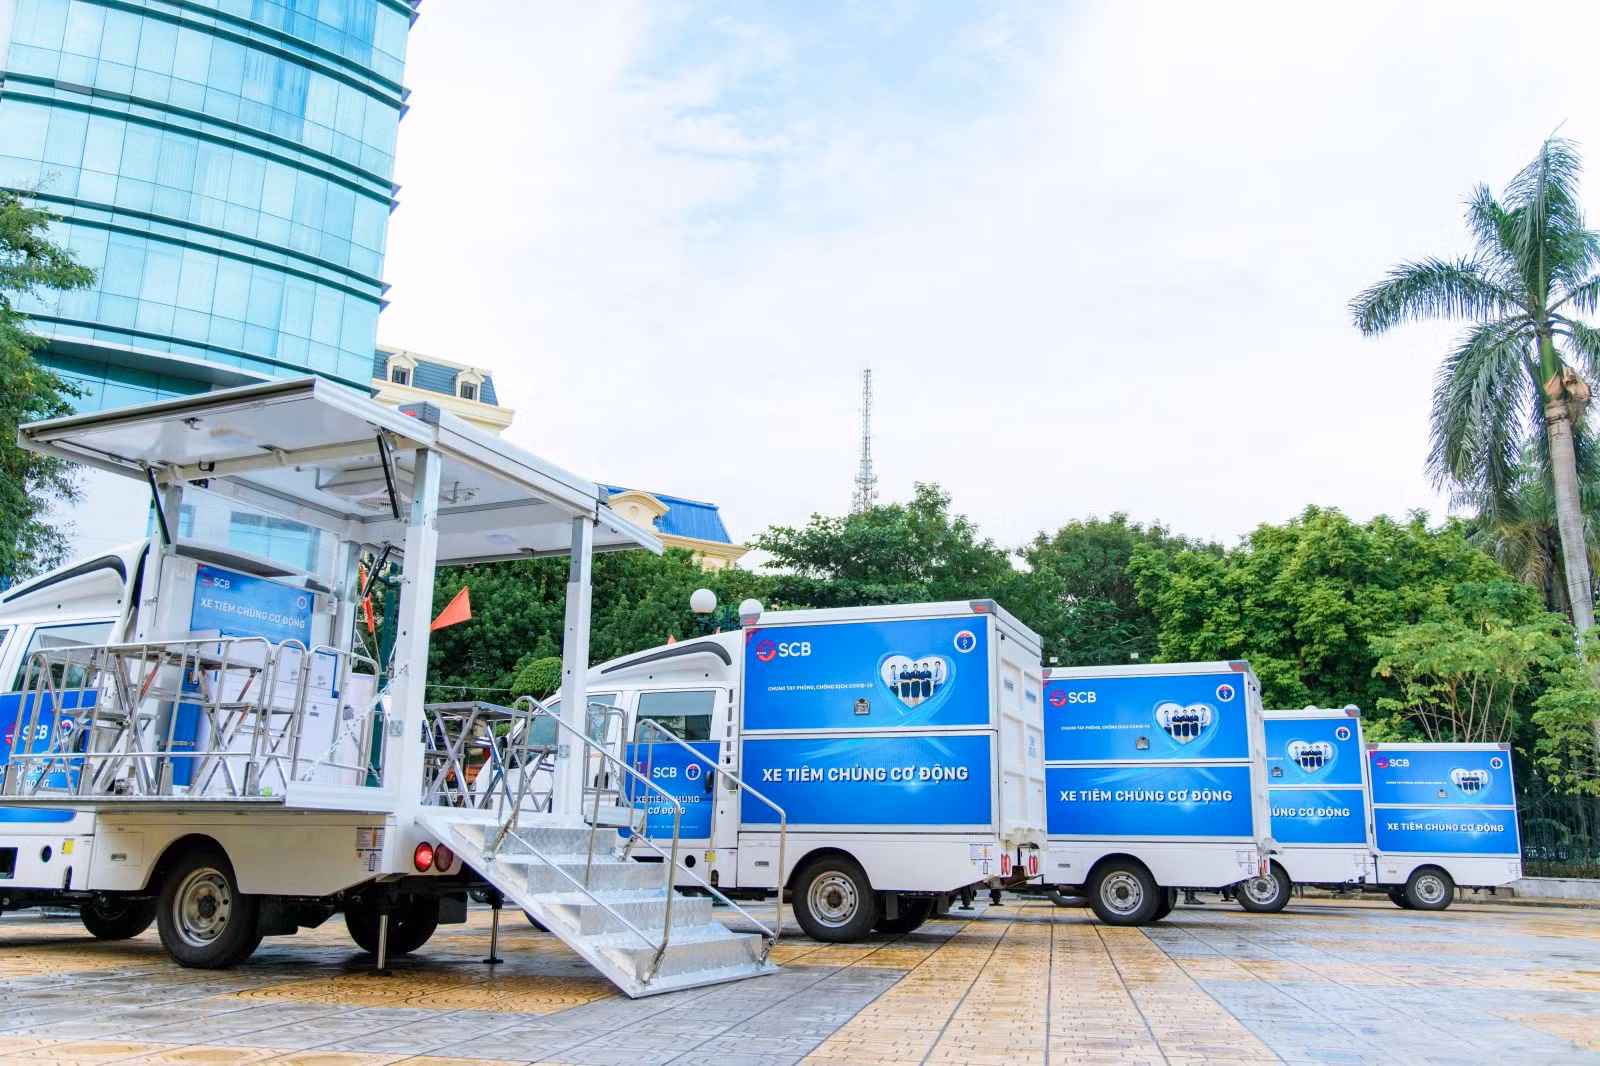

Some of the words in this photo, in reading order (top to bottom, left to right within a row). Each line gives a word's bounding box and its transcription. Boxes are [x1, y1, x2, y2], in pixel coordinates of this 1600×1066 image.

[213, 577, 230, 589] SCB
[201, 597, 212, 609] XE
[778, 642, 812, 657] SCB
[1068, 691, 1096, 704] SCB
[1389, 758, 1409, 767] SCB
[653, 767, 677, 779] SCB
[762, 768, 782, 782] XE
[786, 765, 824, 782] TIÊM
[828, 763, 887, 782] CHỦNG
[890, 765, 916, 781] CƠ
[918, 763, 969, 784] ĐỘNG
[671, 793, 700, 803] HỦNG
[1060, 790, 1077, 801] XE
[1080, 788, 1112, 802] TIÊM
[1115, 787, 1165, 802] CHỦNG
[1168, 789, 1189, 802] CƠ
[1191, 787, 1233, 804] ĐỘNG
[648, 806, 660, 815] CƠ
[1298, 806, 1316, 817] CƠ
[1318, 805, 1350, 819] ĐỘNG
[1387, 822, 1399, 831] XE
[1401, 821, 1423, 831] TIÊM
[1461, 823, 1475, 832] CƠ
[1477, 822, 1504, 834] ĐỘNG
